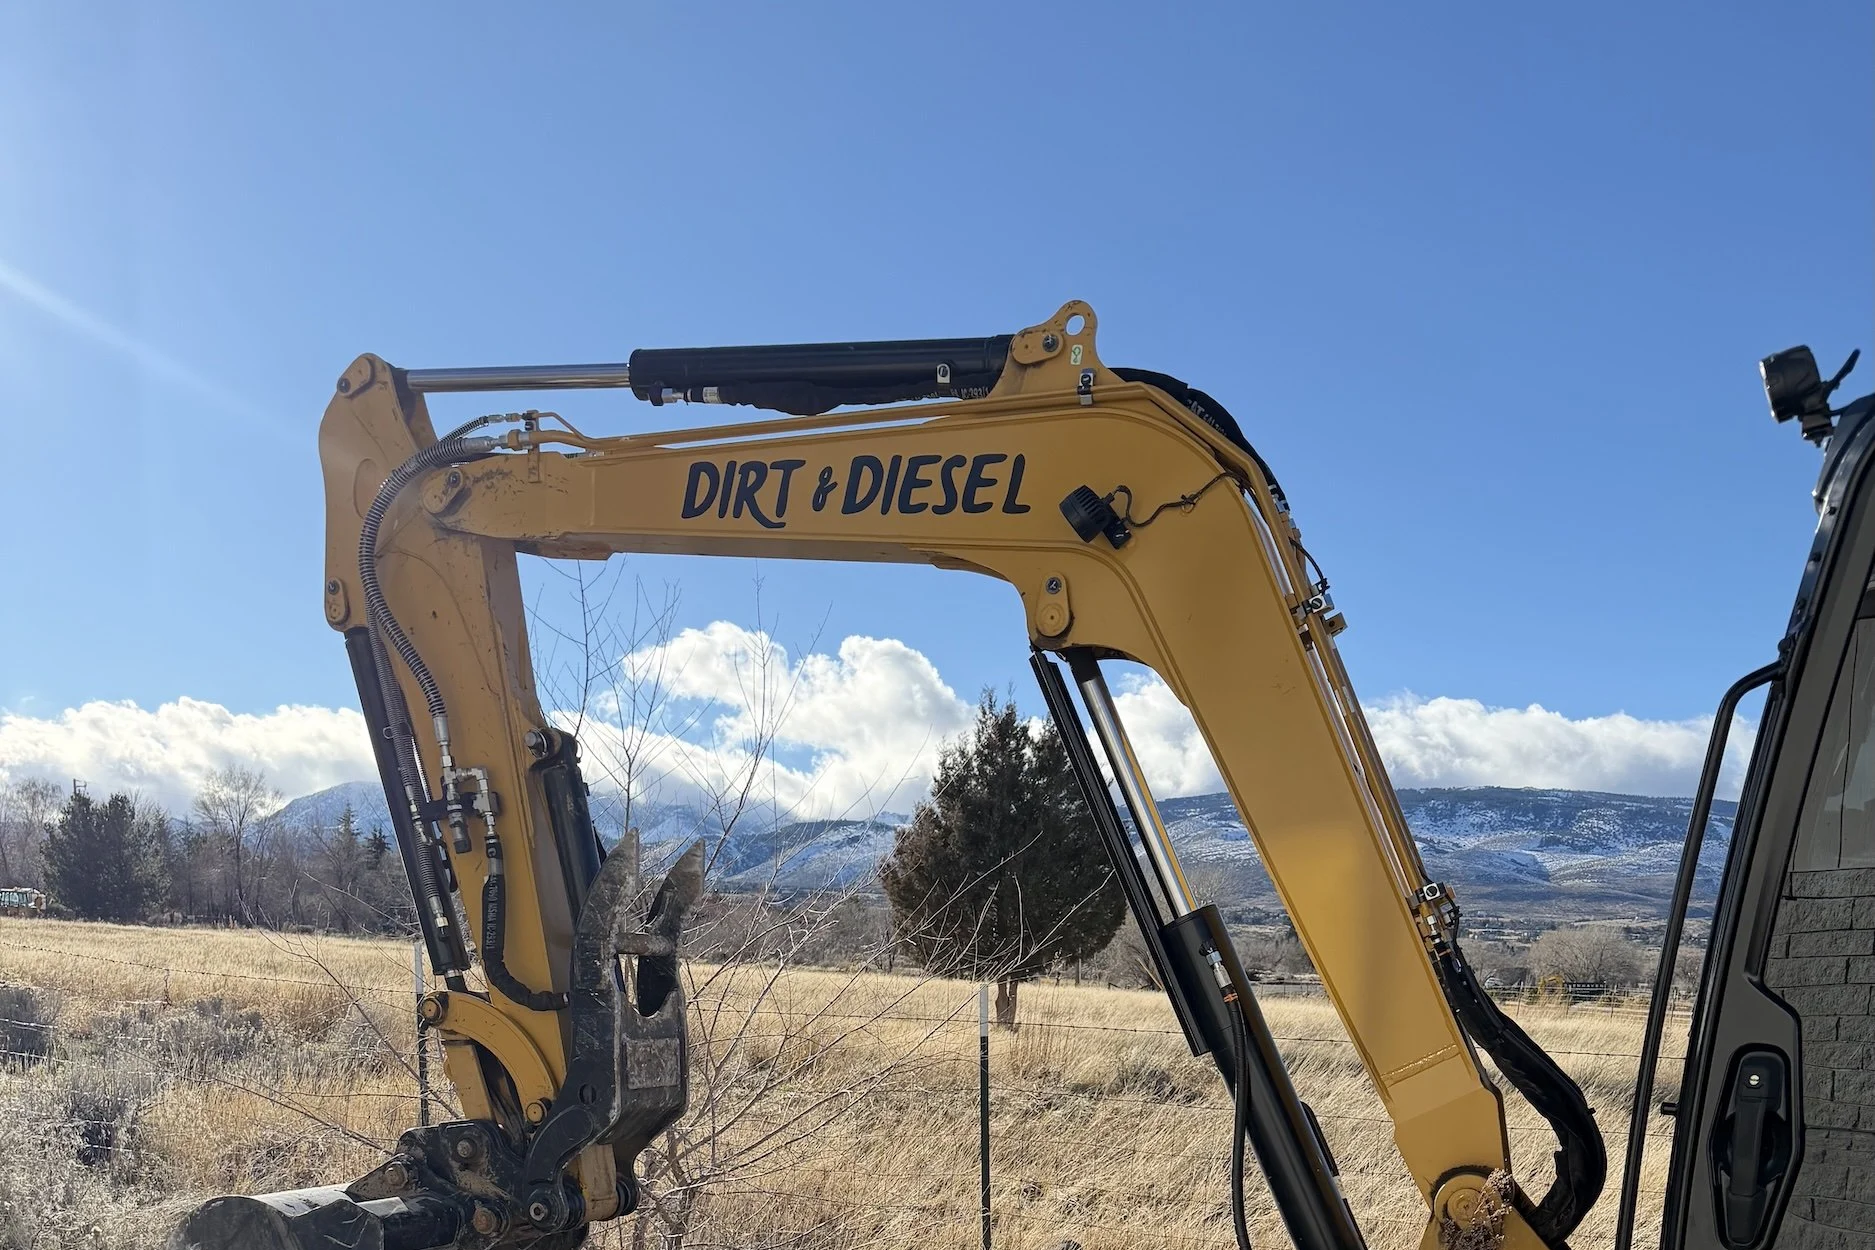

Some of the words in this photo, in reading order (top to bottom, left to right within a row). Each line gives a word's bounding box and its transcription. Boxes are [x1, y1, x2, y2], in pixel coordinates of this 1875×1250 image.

[681, 459, 806, 529] DIRT
[811, 465, 838, 512] &
[841, 453, 1031, 516] DIESEL
